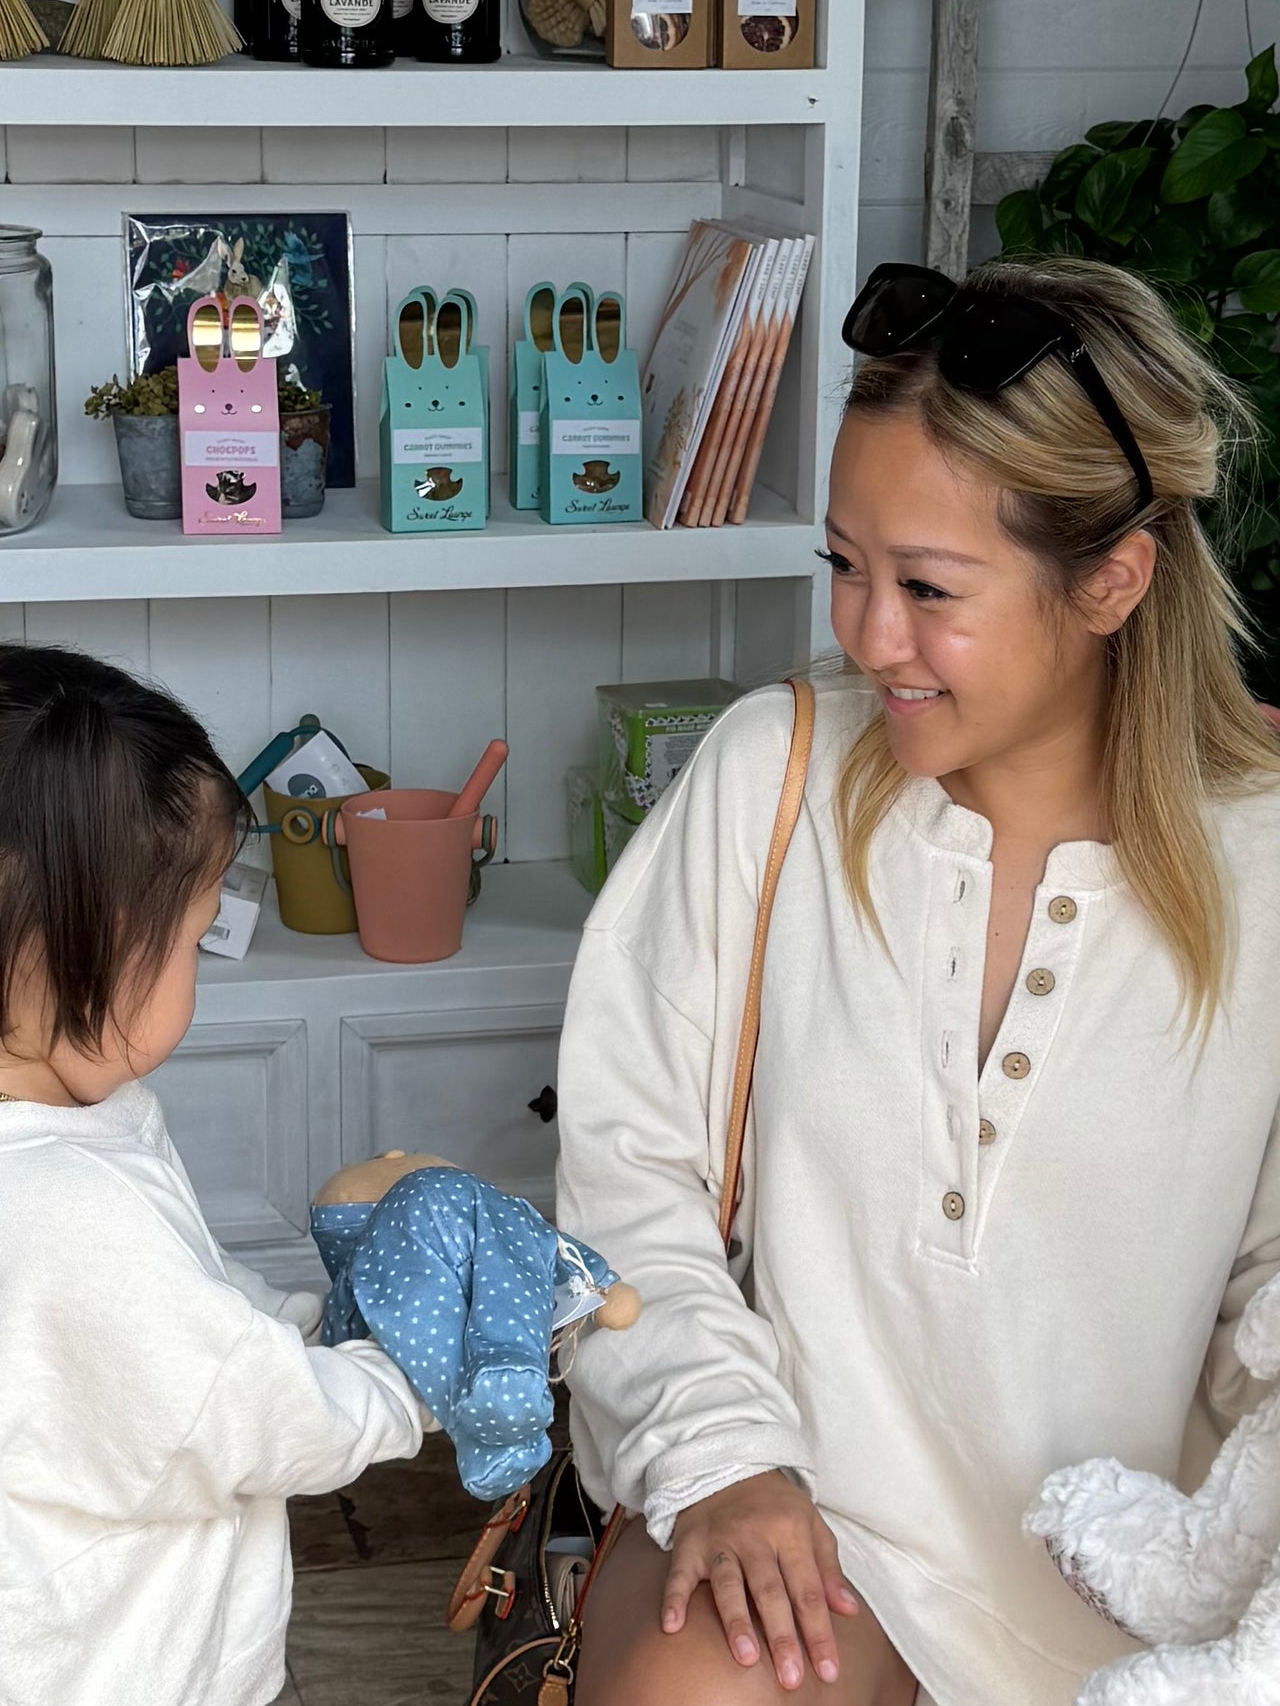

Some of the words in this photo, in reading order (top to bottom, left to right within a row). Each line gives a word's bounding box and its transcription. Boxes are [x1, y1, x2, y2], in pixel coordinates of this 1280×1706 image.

[561, 434, 592, 442] CARROT
[592, 434, 631, 442] GUMMIES
[206, 445, 257, 455] CHOCPOPS
[434, 442, 473, 451] GUMMIES
[564, 498, 598, 515] Sweet
[599, 498, 631, 513] Lounge
[406, 505, 439, 522] Sweet
[441, 505, 474, 522] Lounge
